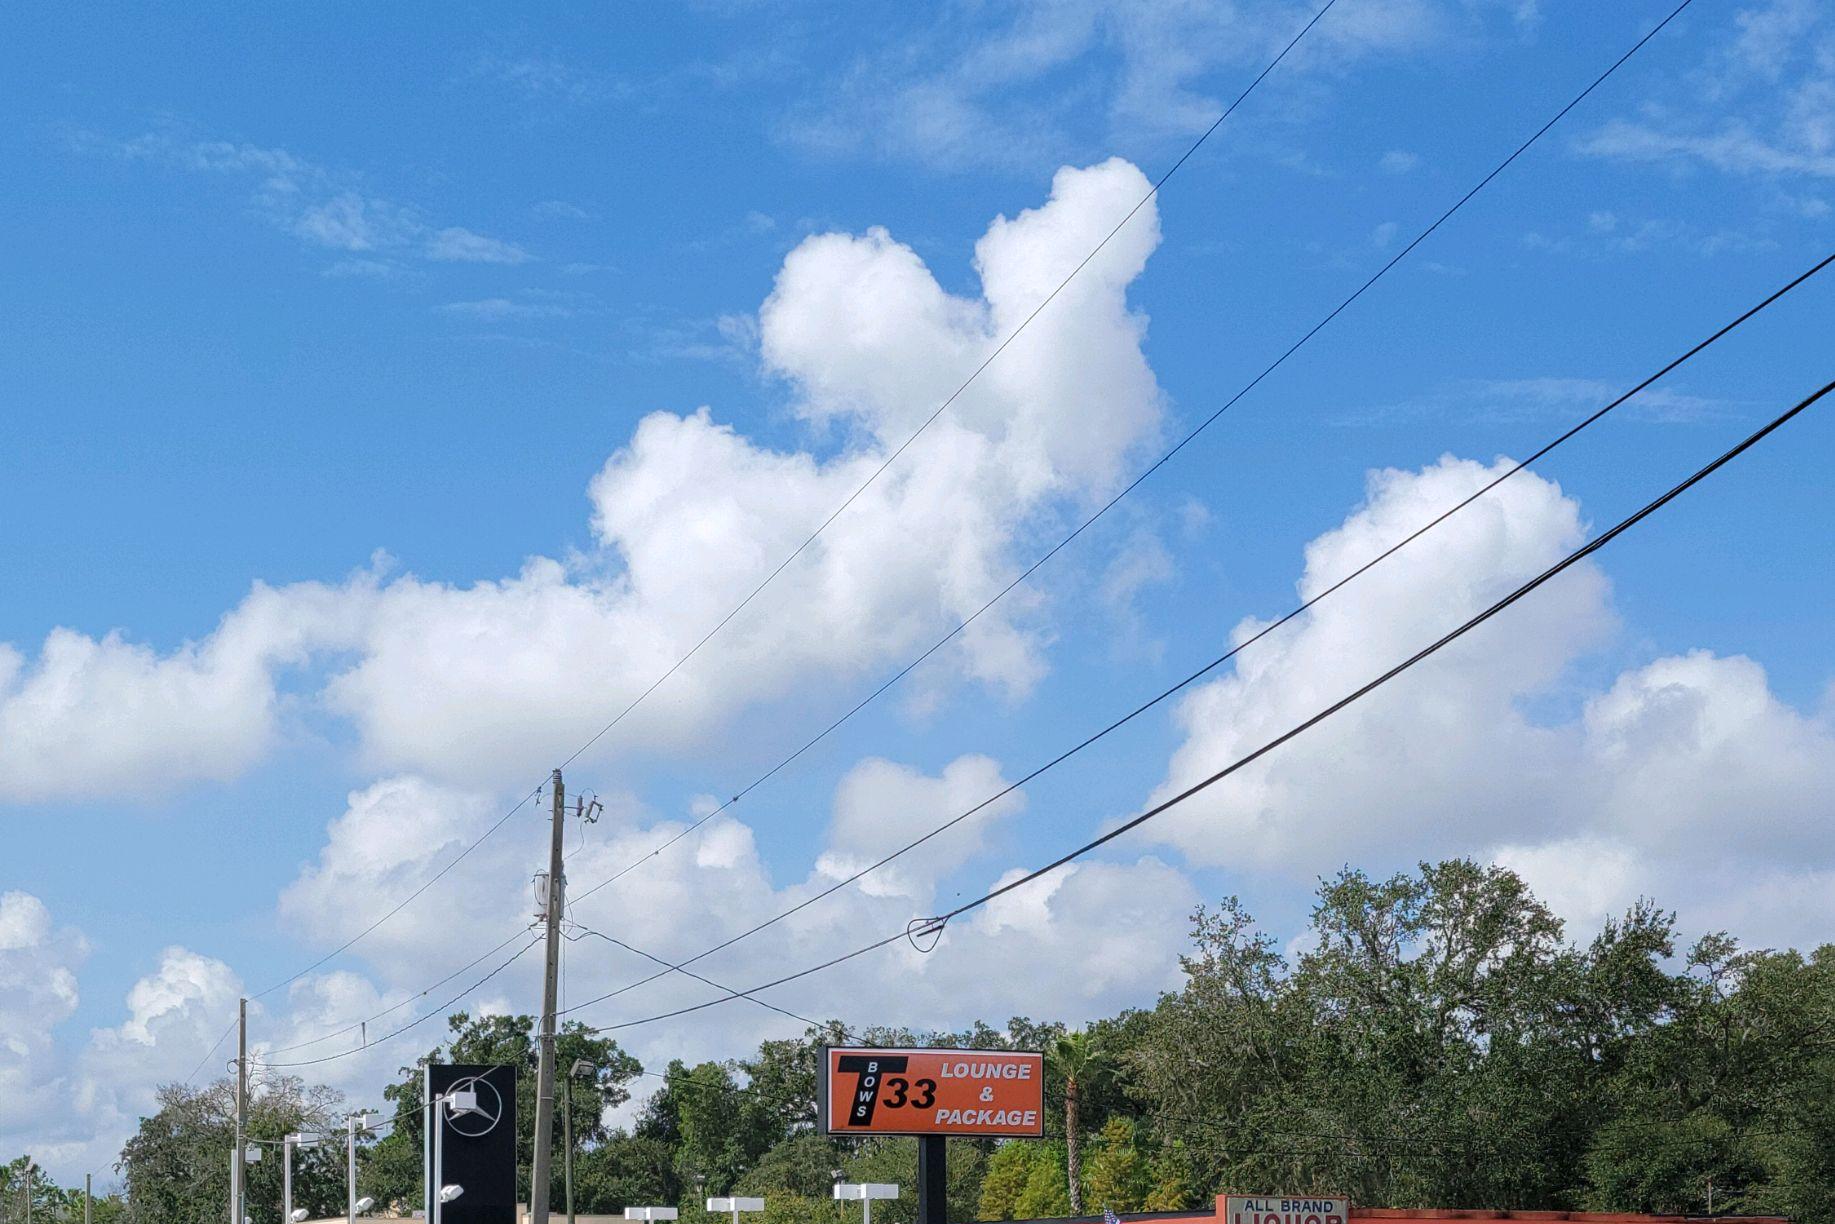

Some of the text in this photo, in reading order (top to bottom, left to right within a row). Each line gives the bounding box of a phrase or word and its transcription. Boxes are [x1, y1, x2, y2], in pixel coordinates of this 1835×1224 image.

[941, 1062, 1032, 1080] LOUNGE
[837, 1055, 937, 1126] T BOWS 33
[979, 1086, 994, 1102] &
[934, 1109, 1037, 1126] PACKAGE
[1244, 1200, 1334, 1213] ALL BRAND
